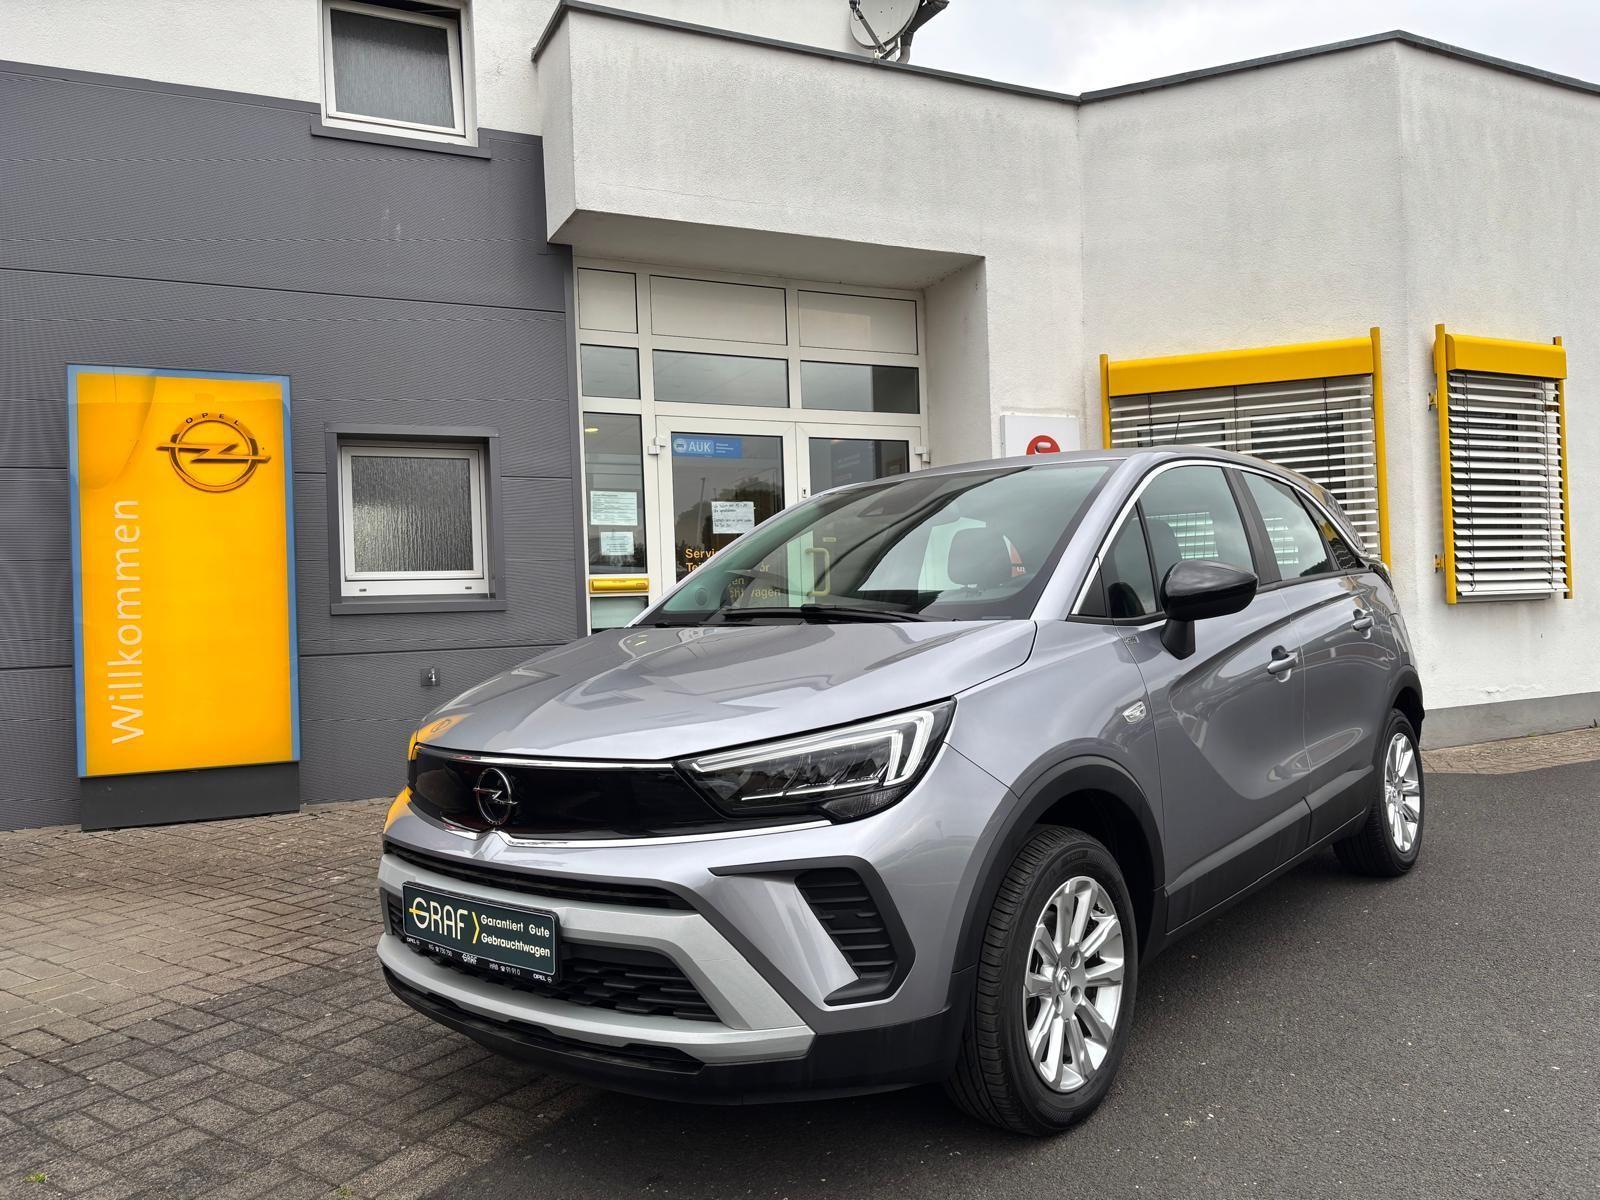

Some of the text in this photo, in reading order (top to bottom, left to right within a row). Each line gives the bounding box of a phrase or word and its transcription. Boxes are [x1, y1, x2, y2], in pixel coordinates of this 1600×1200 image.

[185, 412, 240, 426] OPEL
[688, 441, 711, 453] AUK
[685, 548, 716, 559] Servi
[107, 500, 145, 744] Willkommen
[409, 897, 468, 940] GRAF
[480, 914, 550, 938] Garantiert Gute
[481, 932, 551, 958] Gebrauchtwagen
[532, 973, 546, 982] OPEL
